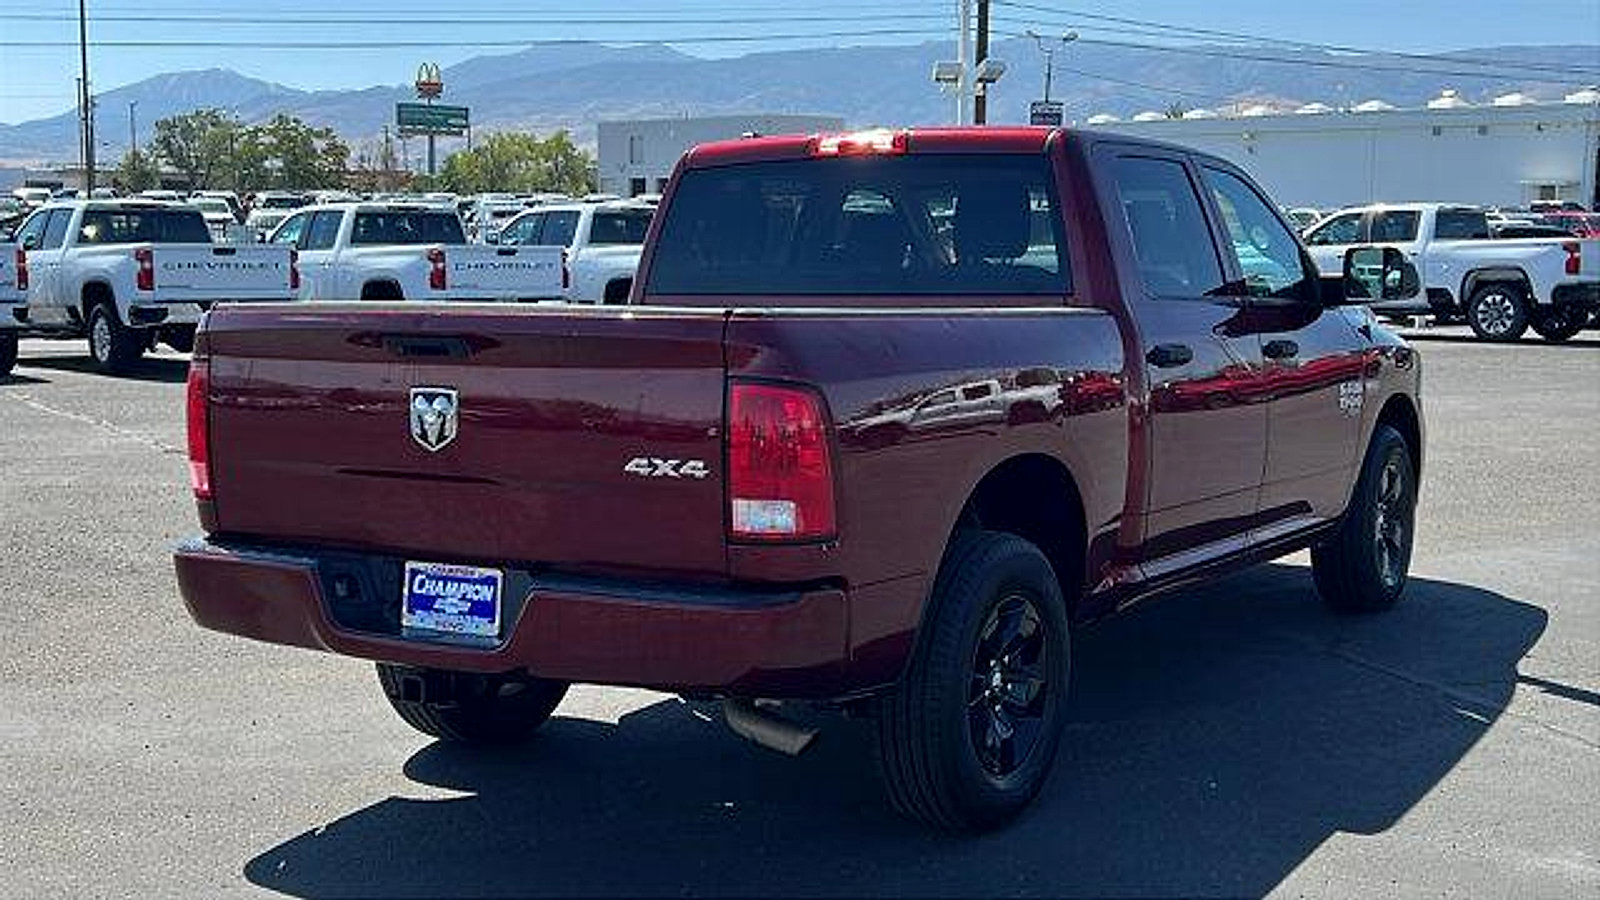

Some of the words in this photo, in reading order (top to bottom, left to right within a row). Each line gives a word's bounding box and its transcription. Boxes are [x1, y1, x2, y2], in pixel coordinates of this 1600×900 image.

[162, 261, 281, 270] CHEVROLET
[454, 262, 556, 270] CHEVROLET
[413, 575, 494, 601] CHAMPION
